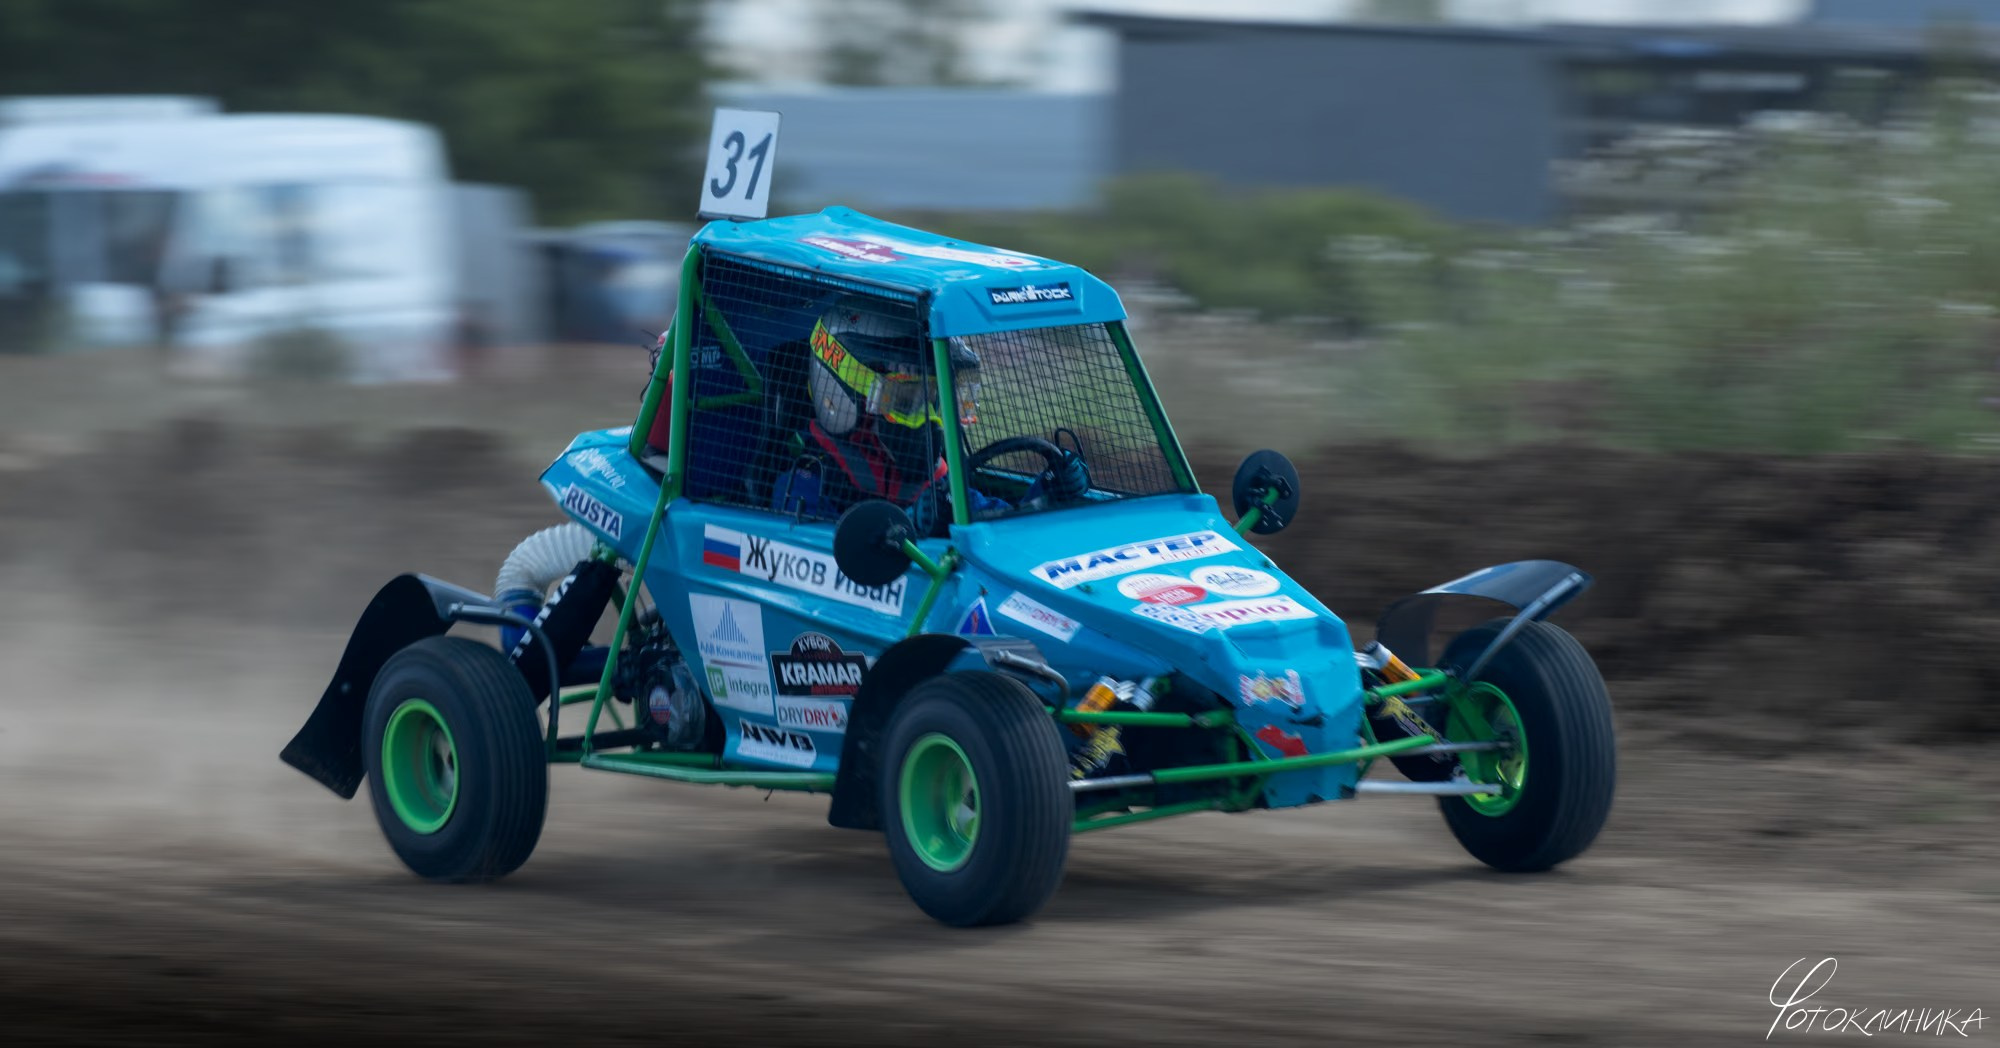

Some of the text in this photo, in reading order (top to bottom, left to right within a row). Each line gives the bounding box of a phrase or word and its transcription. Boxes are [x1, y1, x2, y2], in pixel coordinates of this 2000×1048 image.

[710, 130, 773, 200] 31
[565, 488, 622, 538] RUSTA
[745, 534, 828, 583] Жуков
[1043, 532, 1217, 580] МАСТЕР
[728, 677, 770, 697] integra
[780, 662, 863, 687] KRAMAR
[778, 705, 830, 727] DRYDRY
